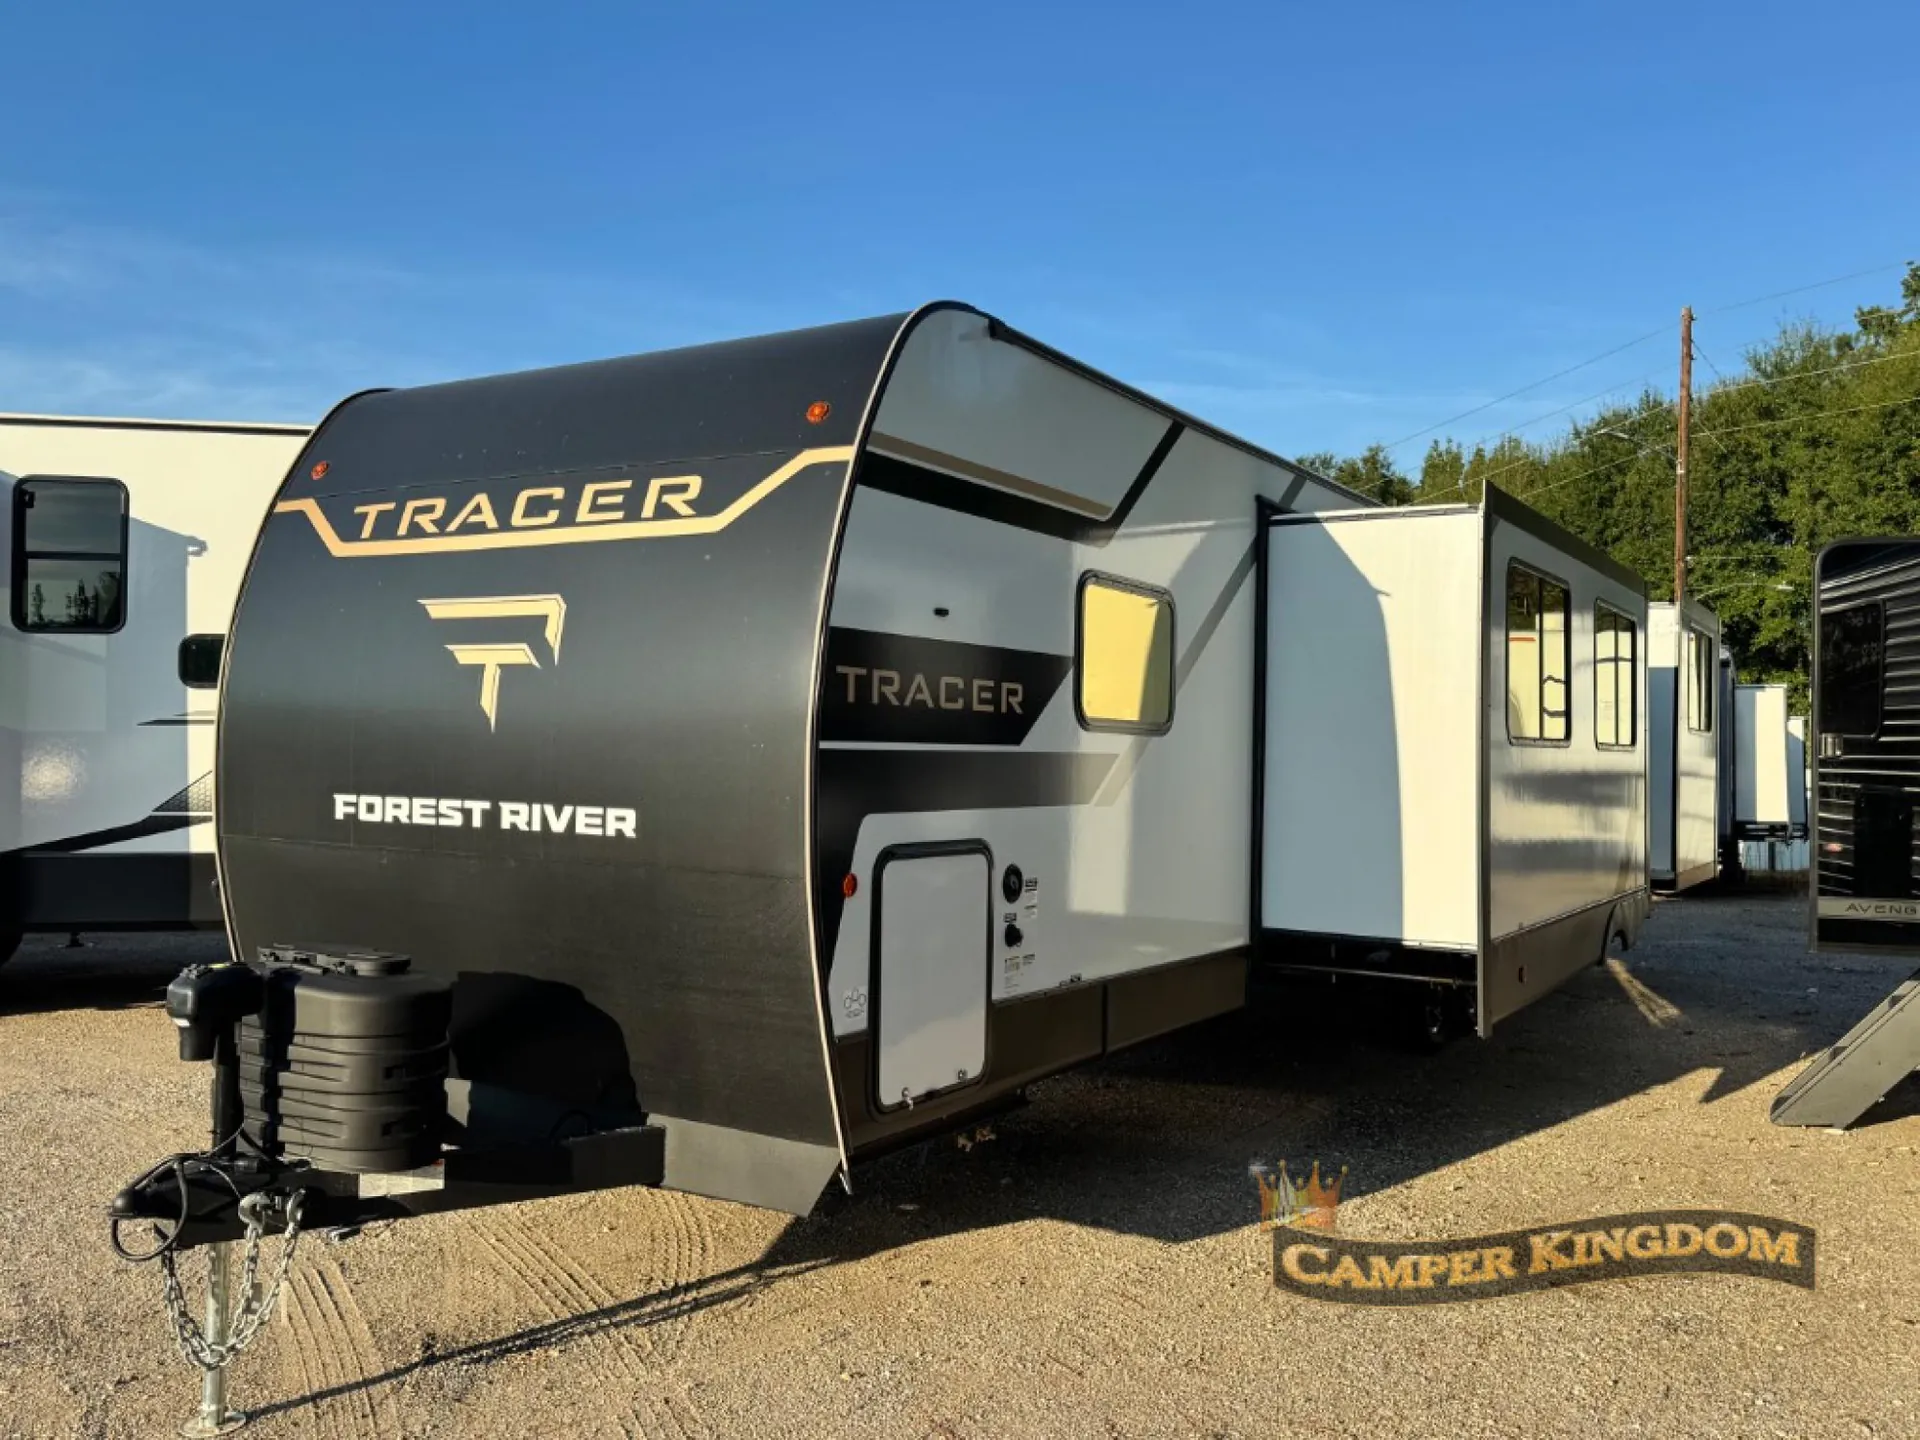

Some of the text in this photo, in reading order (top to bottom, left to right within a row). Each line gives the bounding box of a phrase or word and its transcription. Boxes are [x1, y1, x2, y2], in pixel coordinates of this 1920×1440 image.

[353, 475, 703, 539] TRACER
[836, 665, 1024, 714] TRACER
[333, 794, 638, 838] FOREST RIVER
